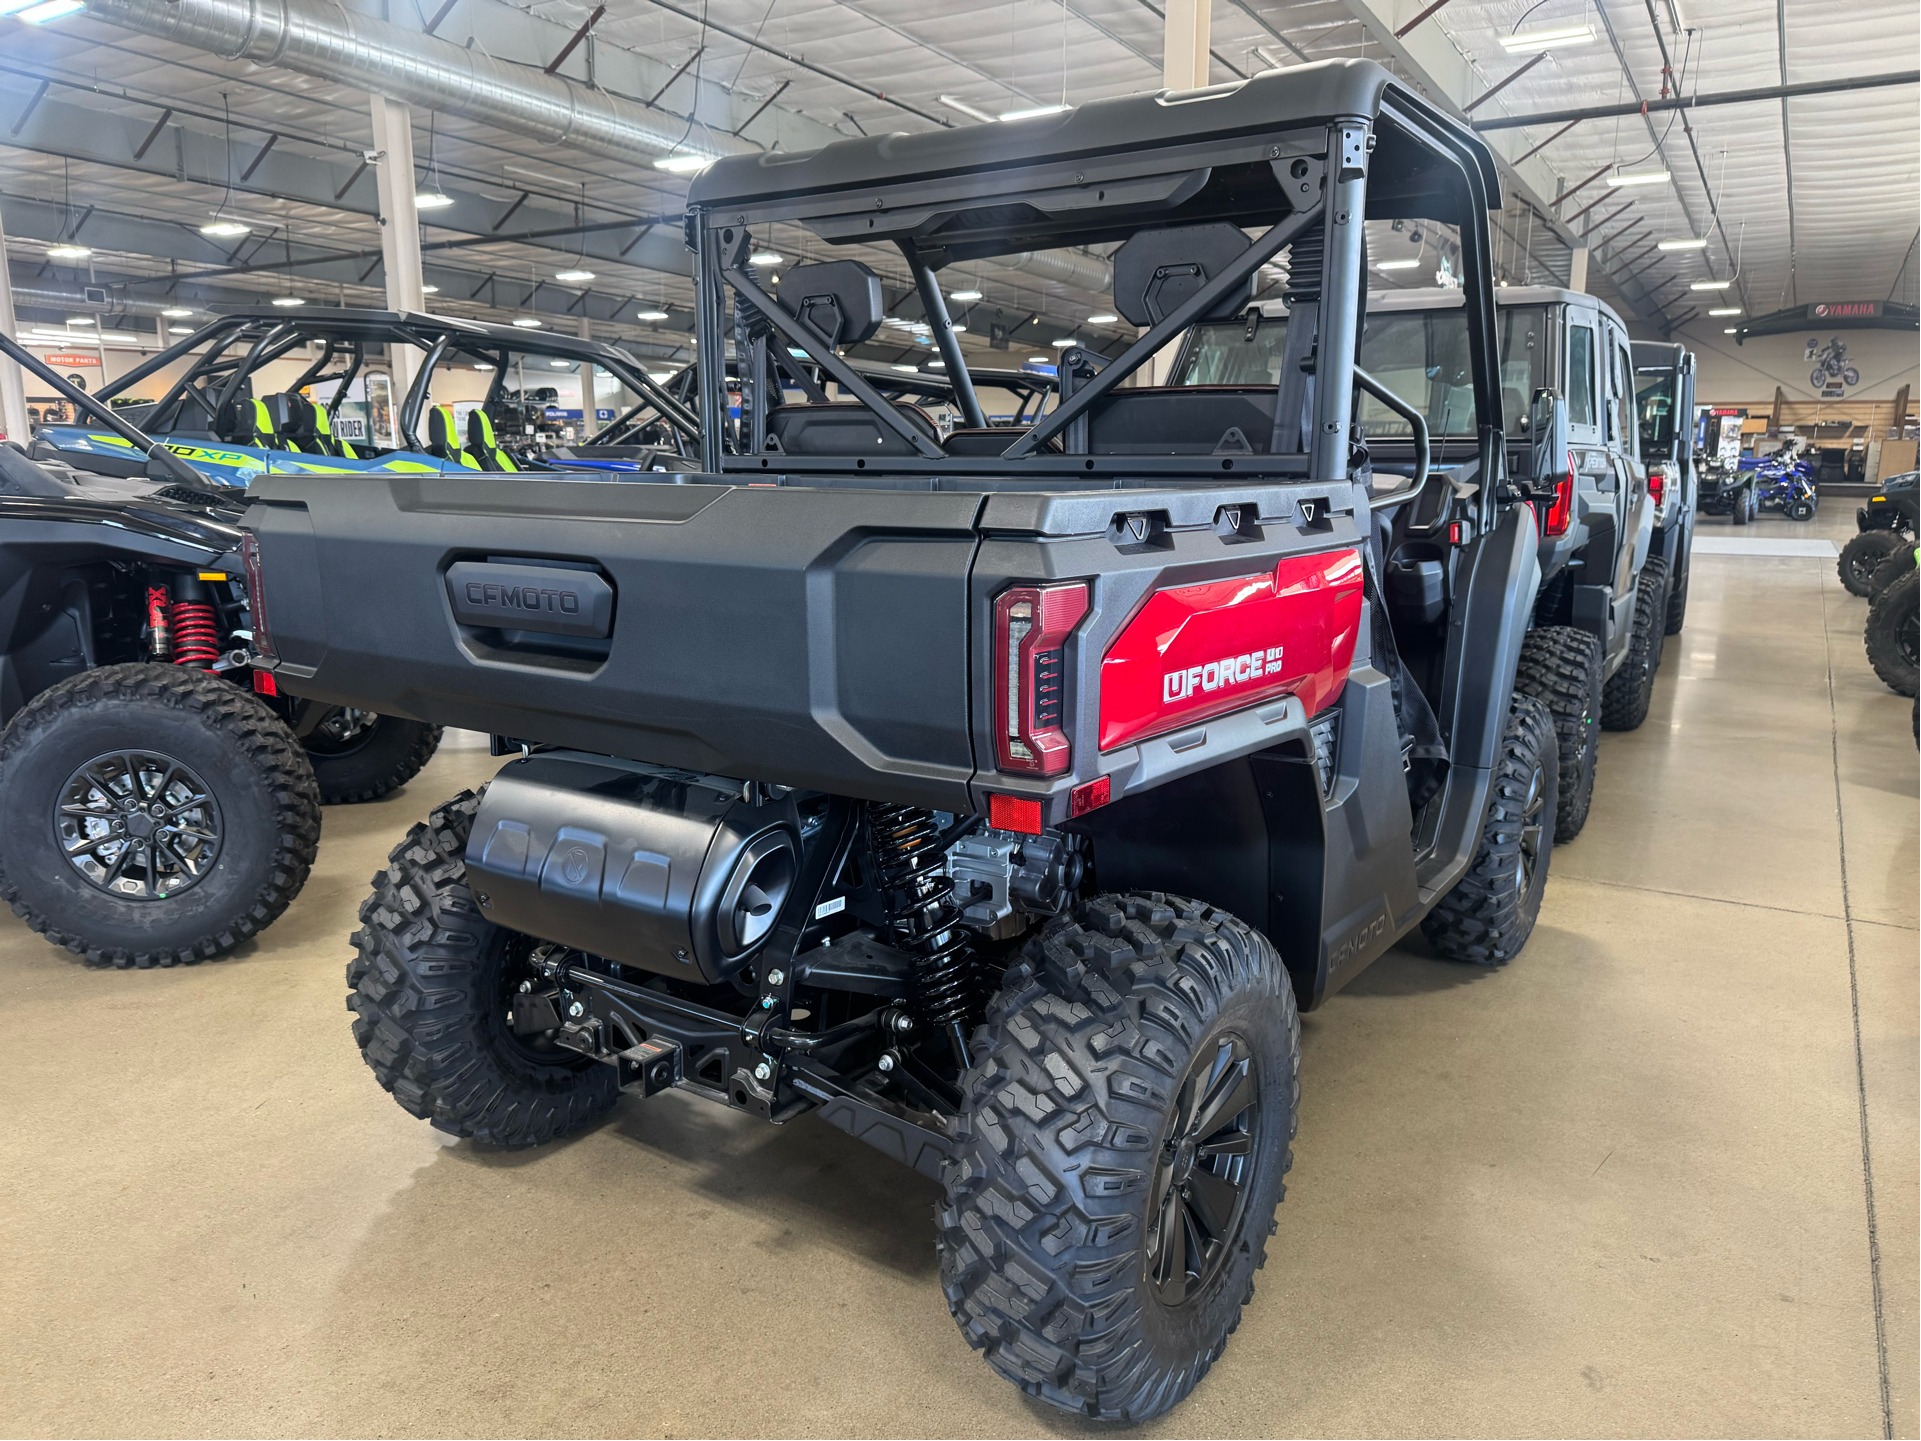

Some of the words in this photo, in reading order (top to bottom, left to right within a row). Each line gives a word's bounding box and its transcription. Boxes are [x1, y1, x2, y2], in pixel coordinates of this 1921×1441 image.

[1829, 303, 1875, 316] YAMAHA
[340, 420, 364, 438] RIDER
[197, 450, 242, 461] XP
[466, 582, 580, 615] CFMOTO
[1265, 660, 1283, 676] PRO
[1163, 651, 1265, 704] UFORCE
[1328, 913, 1387, 974] CFMOTO
